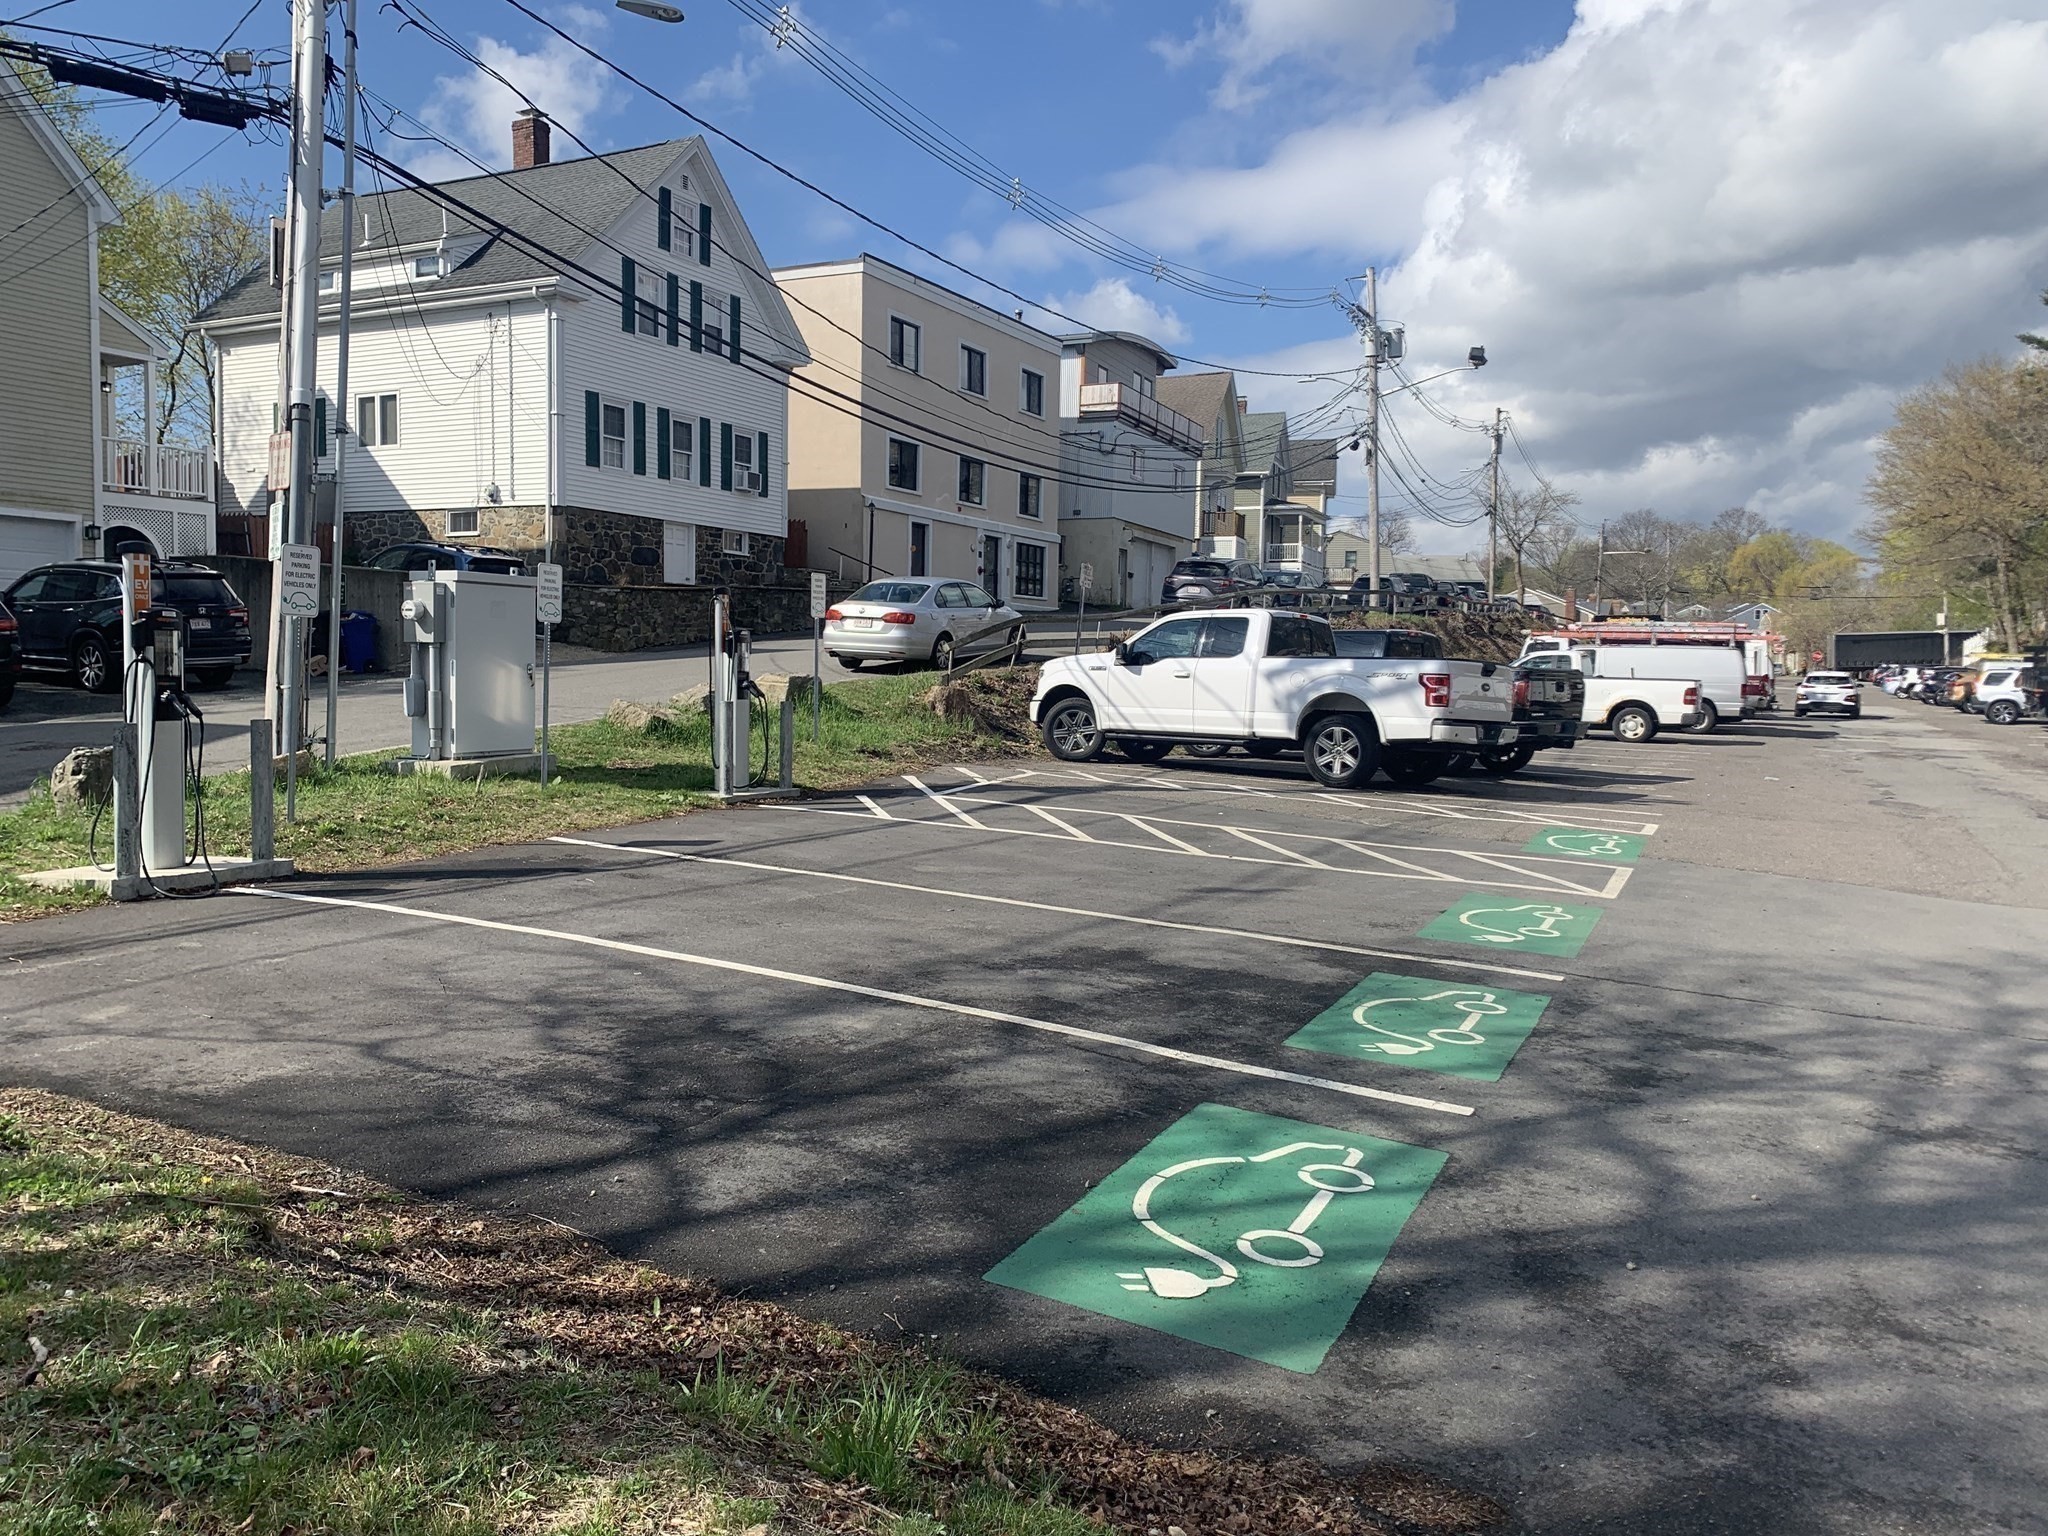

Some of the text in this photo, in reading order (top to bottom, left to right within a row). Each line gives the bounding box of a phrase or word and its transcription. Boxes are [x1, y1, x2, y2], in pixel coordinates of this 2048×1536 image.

[290, 552, 312, 560] RESERVED
[295, 572, 316, 580] ELECTRIC
[135, 579, 148, 590] EV
